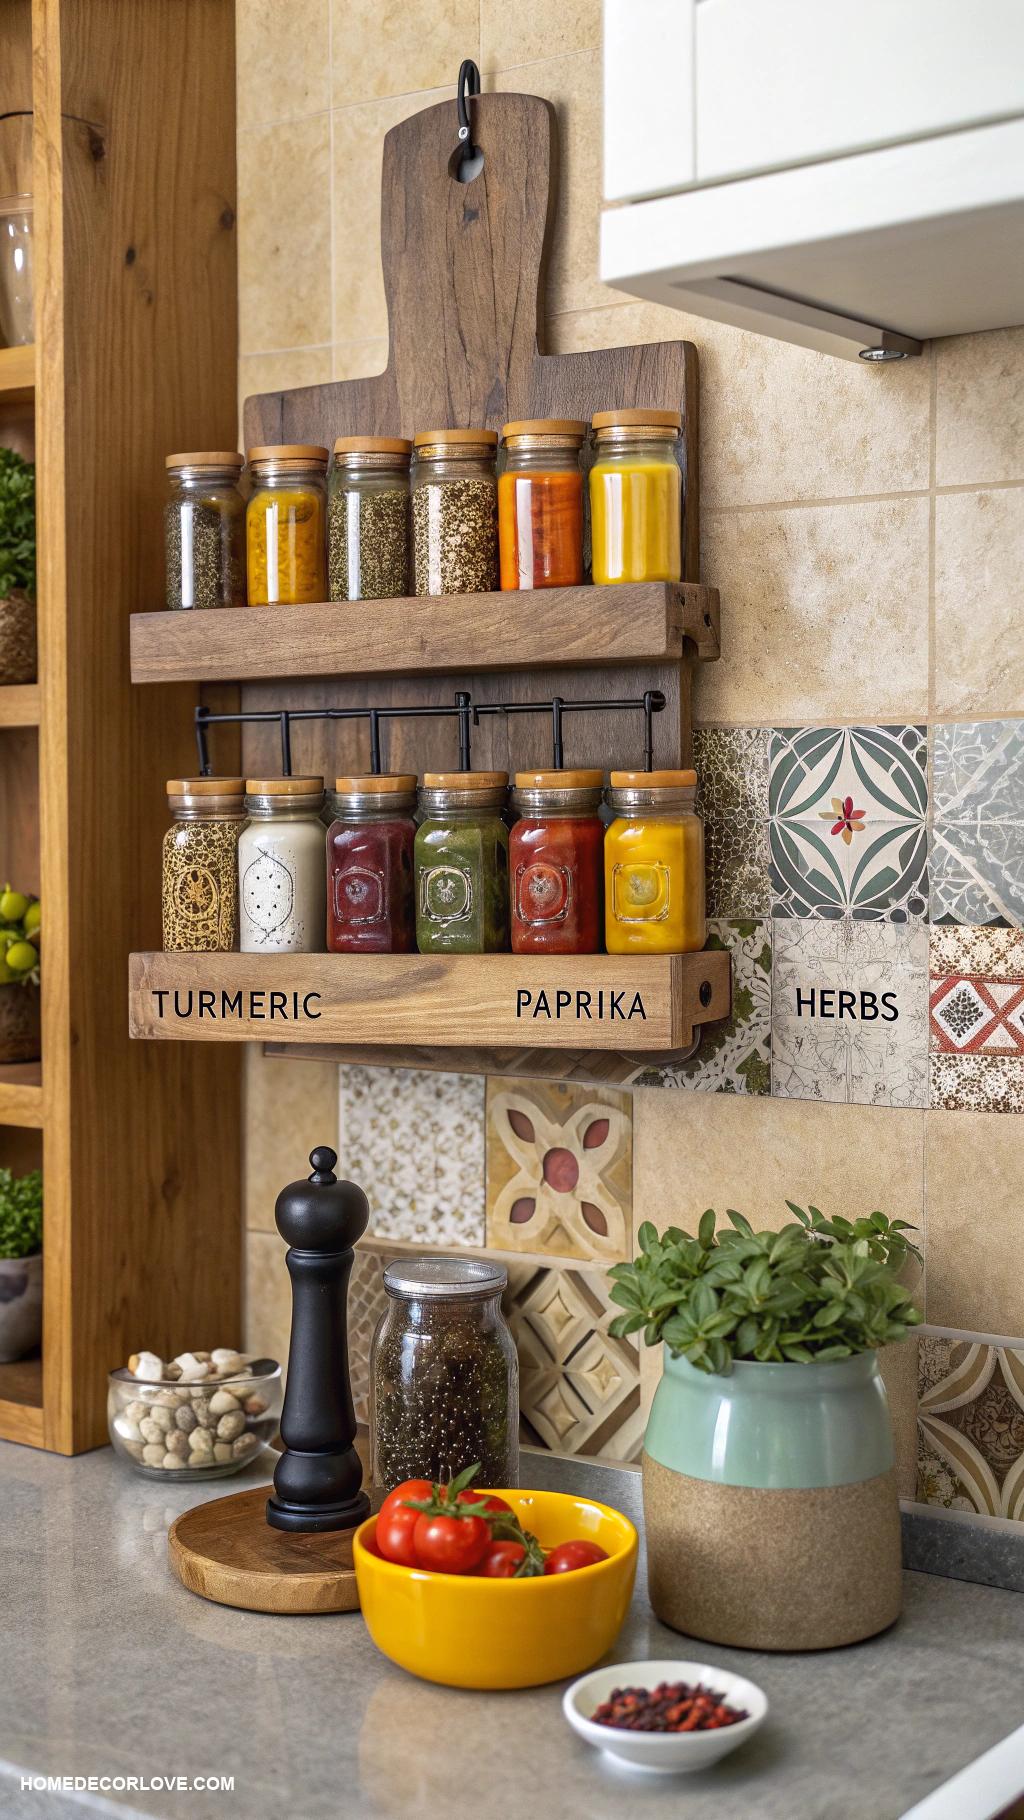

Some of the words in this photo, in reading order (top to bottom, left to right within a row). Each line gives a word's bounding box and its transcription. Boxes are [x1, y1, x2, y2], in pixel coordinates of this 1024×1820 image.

[151, 990, 322, 1019] TURMERIC
[515, 989, 647, 1020] PAPRIKA
[795, 988, 899, 1021] HERBS
